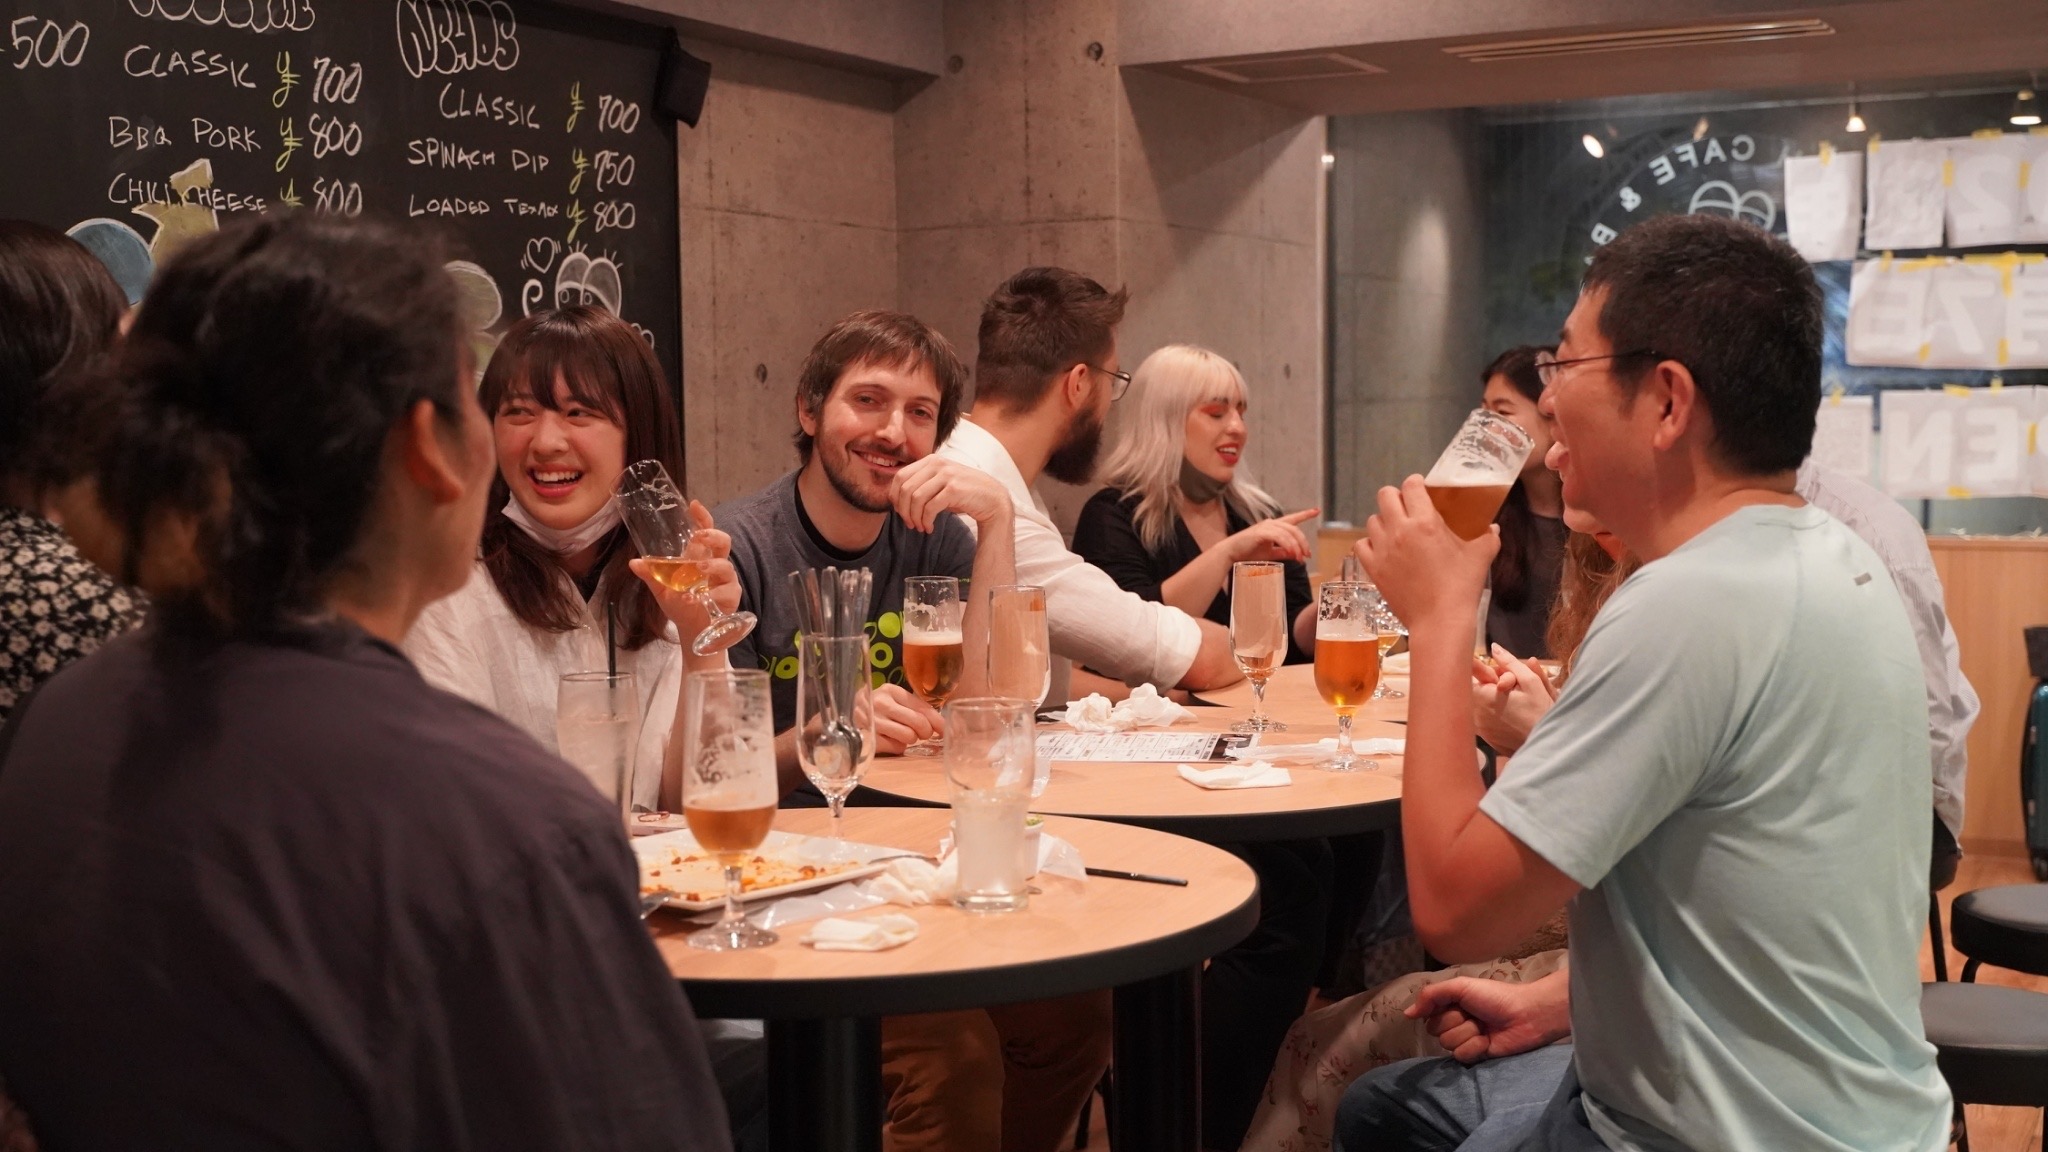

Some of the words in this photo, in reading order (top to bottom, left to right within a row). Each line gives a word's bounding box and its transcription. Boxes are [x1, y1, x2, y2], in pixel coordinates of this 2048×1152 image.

[11, 15, 90, 69] 500
[124, 45, 257, 88] CLASSIC
[439, 82, 540, 129] CLASSIC
[108, 116, 172, 150] BBQ
[192, 117, 262, 152] PORK
[408, 138, 496, 171] SPINACH
[511, 149, 550, 174] DIP
[180, 184, 268, 216] CHEESE
[409, 194, 491, 218] LOADED
